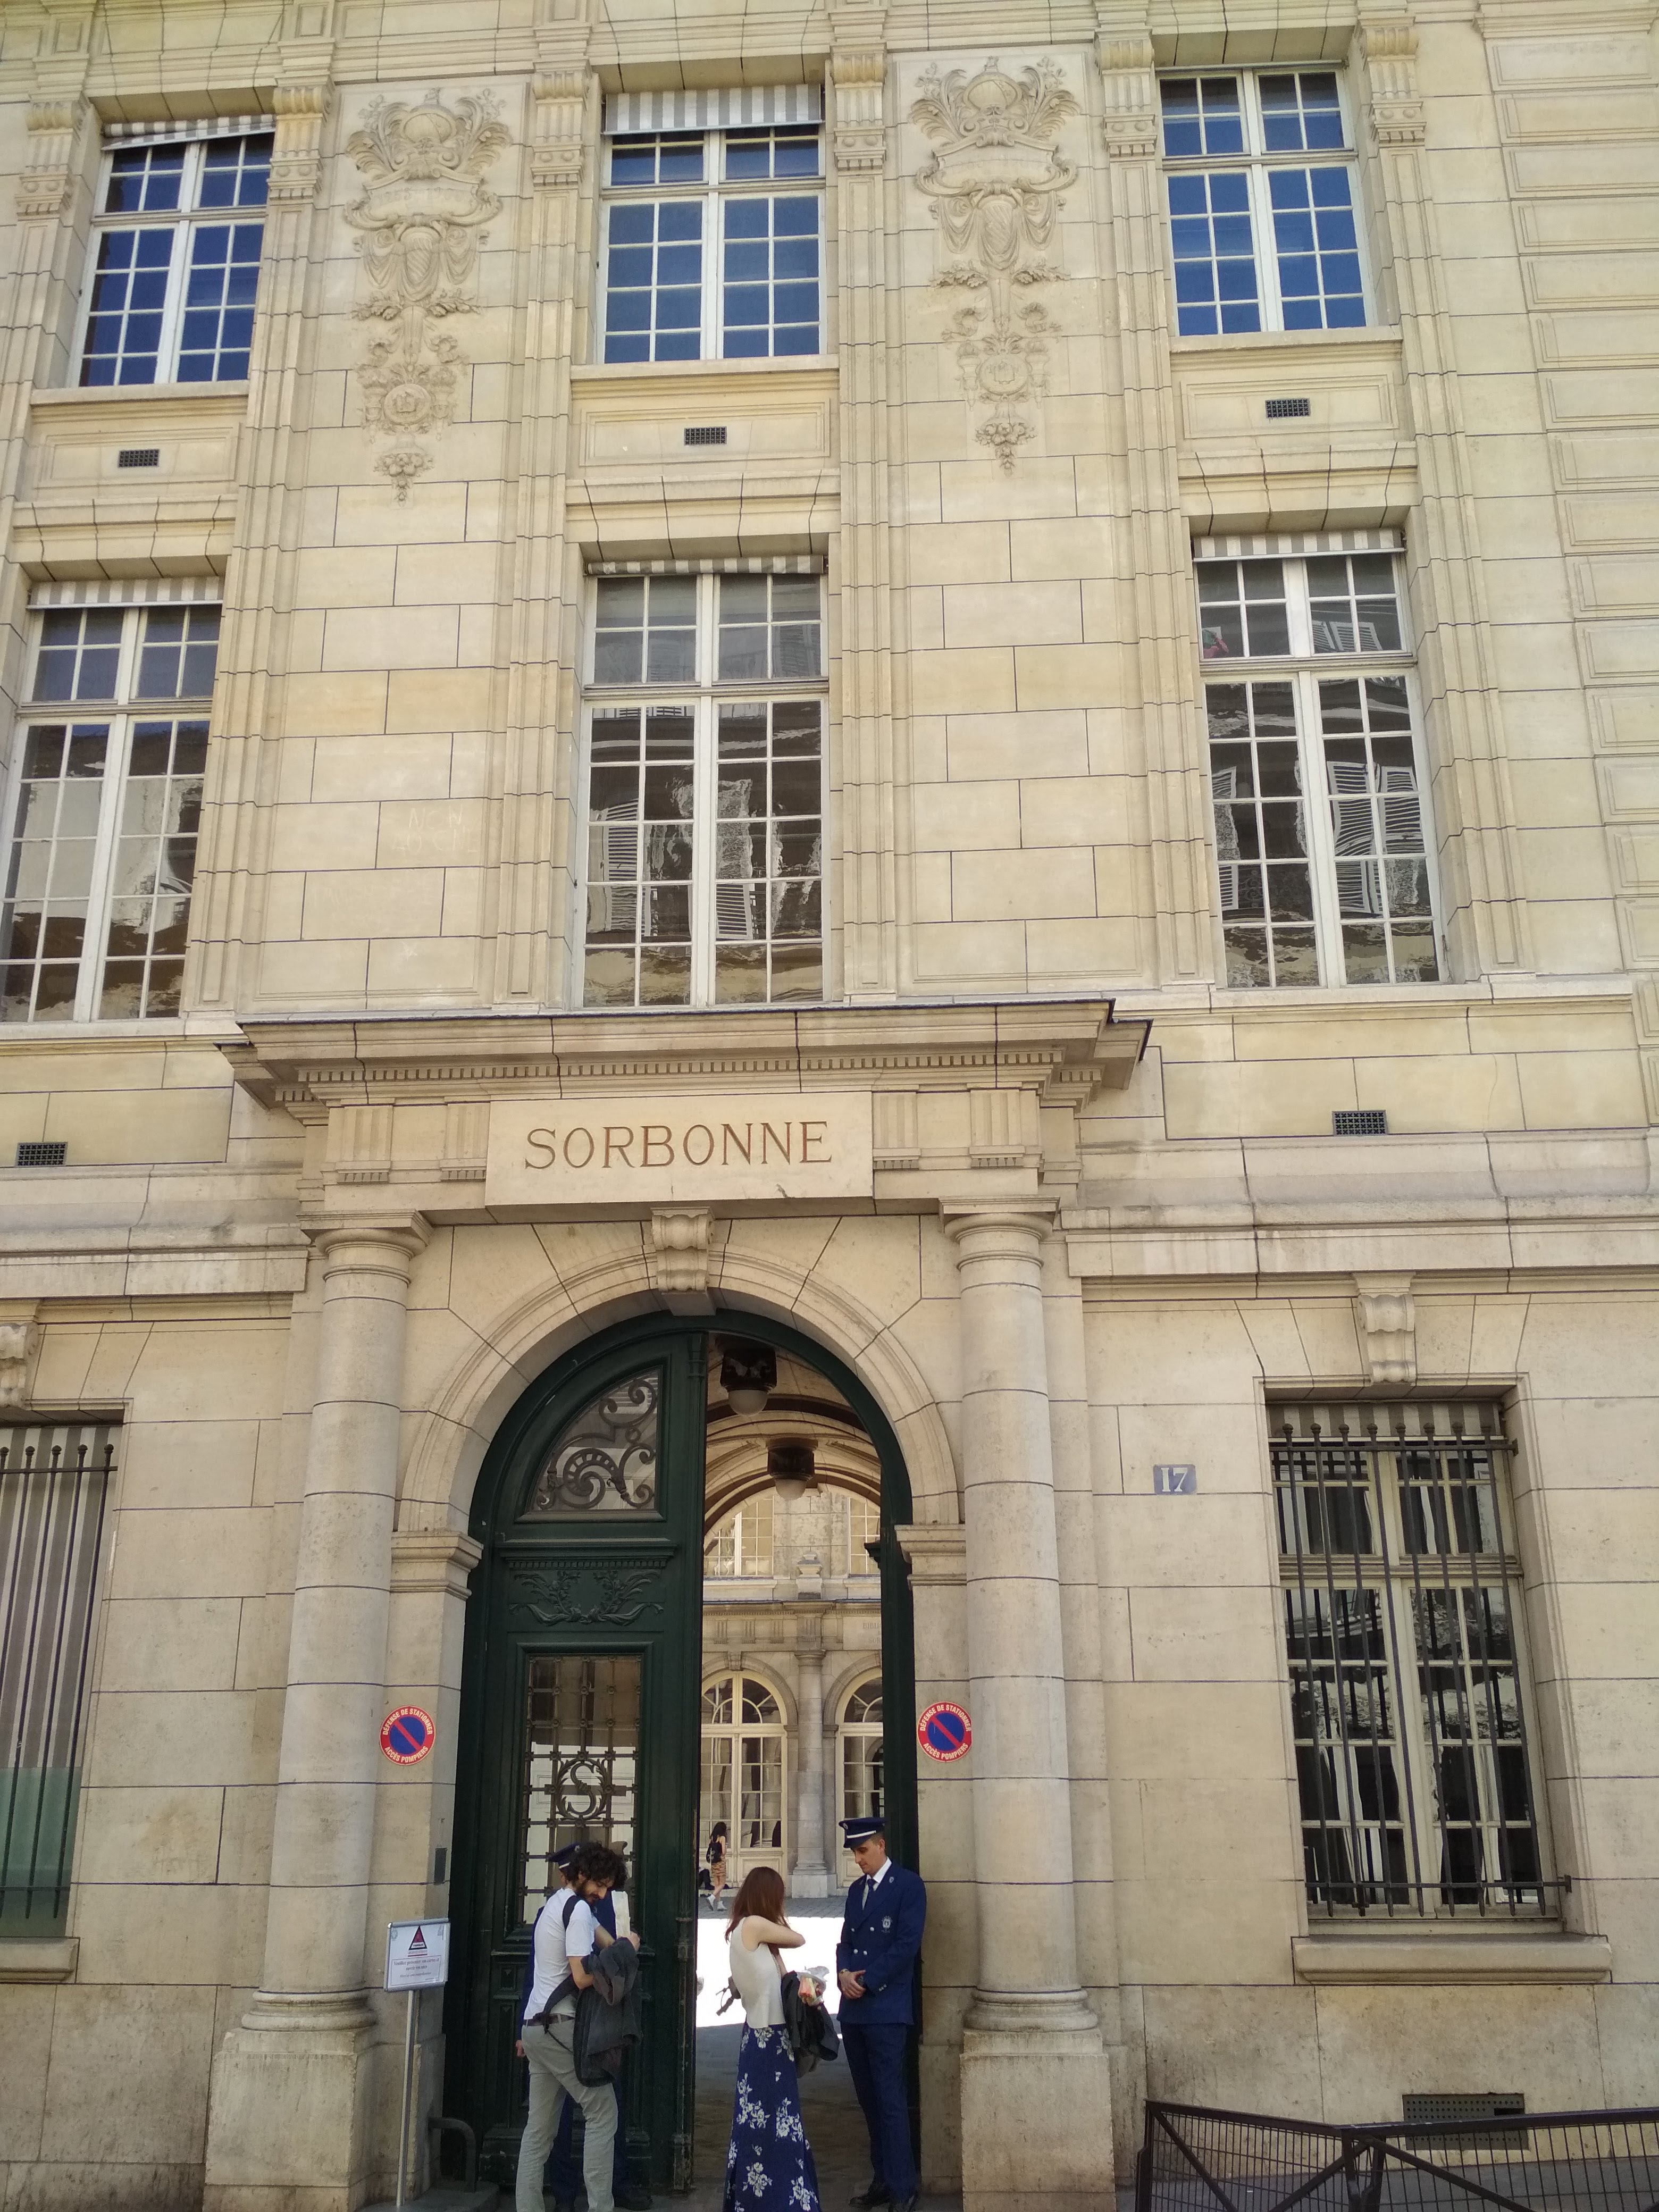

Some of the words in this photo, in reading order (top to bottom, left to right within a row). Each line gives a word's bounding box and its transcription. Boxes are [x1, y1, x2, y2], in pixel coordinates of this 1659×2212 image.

[525, 1120, 832, 1169] SORBONNE
[1161, 1468, 1188, 1492] 17
[382, 1711, 400, 1735] DÉFENSE
[409, 1708, 433, 1735] STATIONNER
[919, 1707, 936, 1731] DÉFENSE
[945, 1704, 971, 1732] STATIONNER
[384, 1746, 400, 1762] ACCÈS
[401, 1746, 429, 1763] POMPIERS
[924, 1742, 941, 1758] ACCÈS
[941, 1742, 968, 1759] POMPIERS
